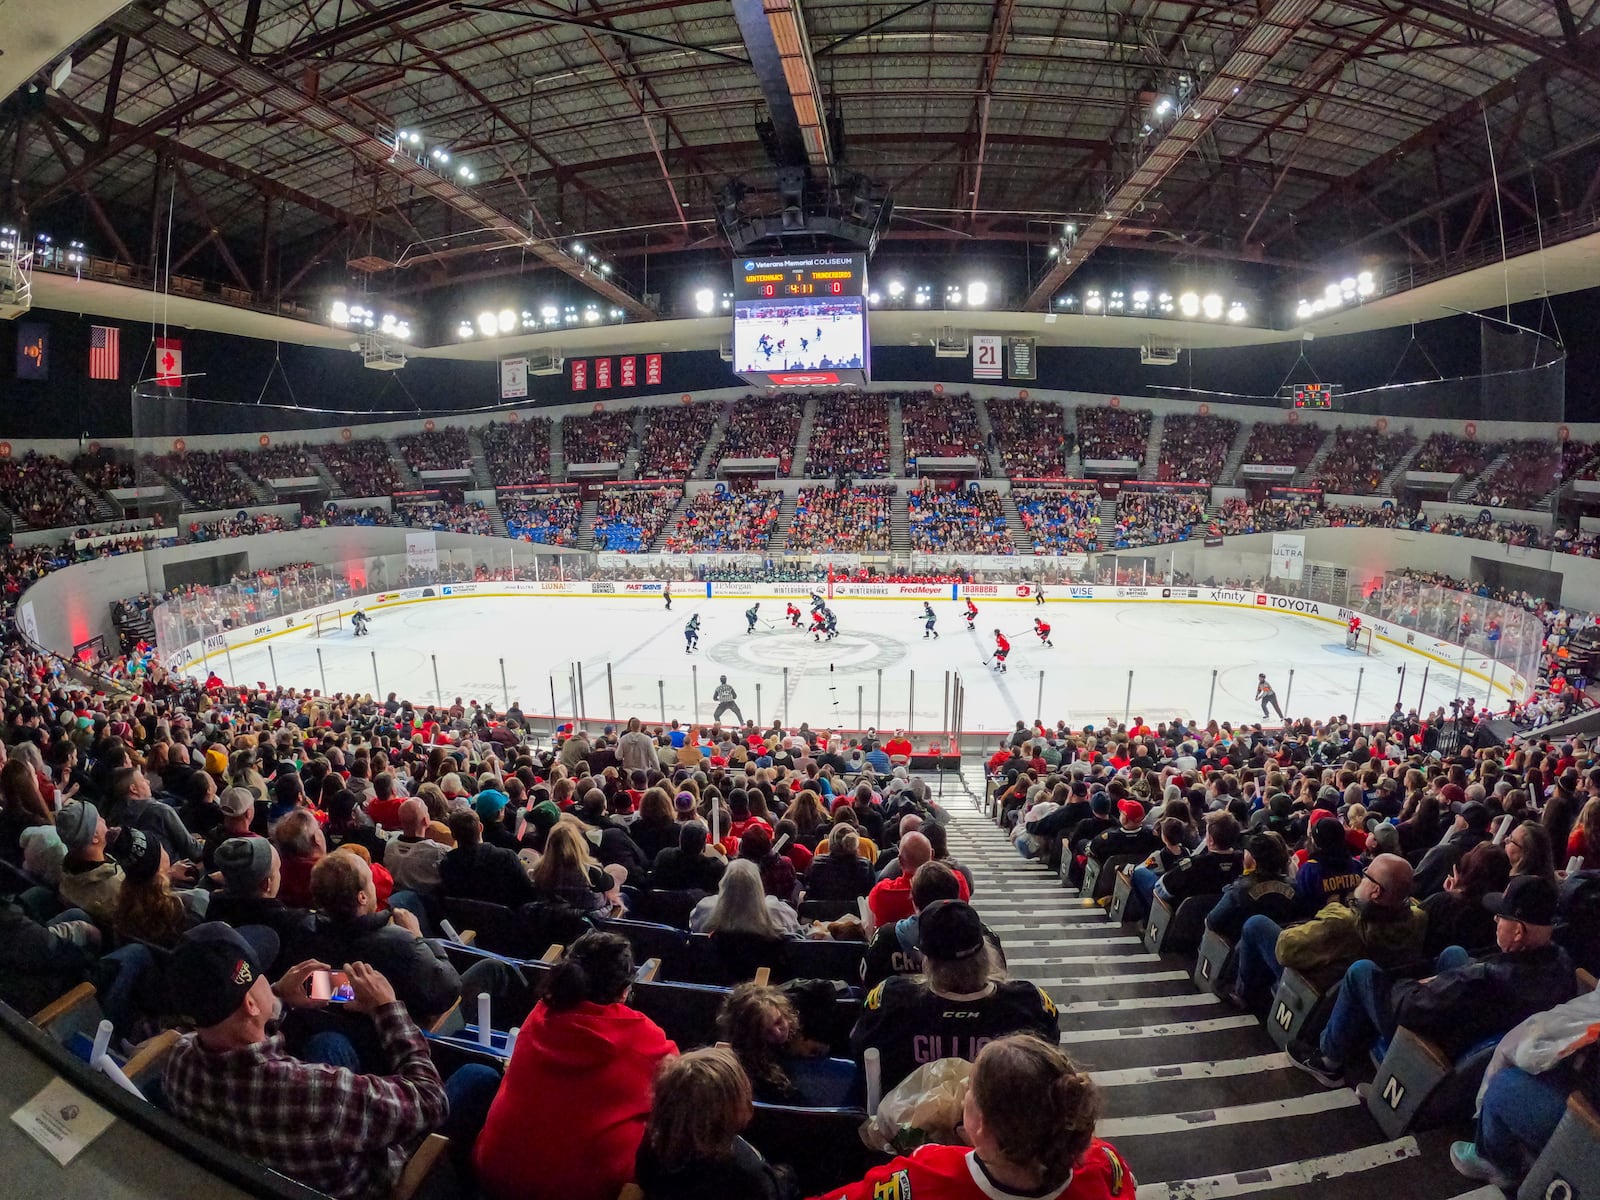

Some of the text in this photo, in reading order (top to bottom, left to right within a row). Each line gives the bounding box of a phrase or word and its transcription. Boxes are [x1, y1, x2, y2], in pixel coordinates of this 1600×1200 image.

[784, 259, 813, 267] Memorial
[766, 285, 773, 295] 0
[833, 282, 840, 293] 0
[979, 346, 996, 365] 21
[1273, 548, 1303, 557] ULTRA
[1070, 587, 1093, 595] WISE
[1210, 589, 1245, 603] xfinity
[1270, 596, 1319, 614] TOYOTA
[207, 634, 223, 649] AVID
[1114, 899, 1119, 910] J
[1150, 924, 1158, 942] K
[1202, 958, 1210, 979] L
[942, 1011, 980, 1019] CCM
[1276, 1001, 1293, 1031] M
[1382, 1076, 1405, 1109] N
